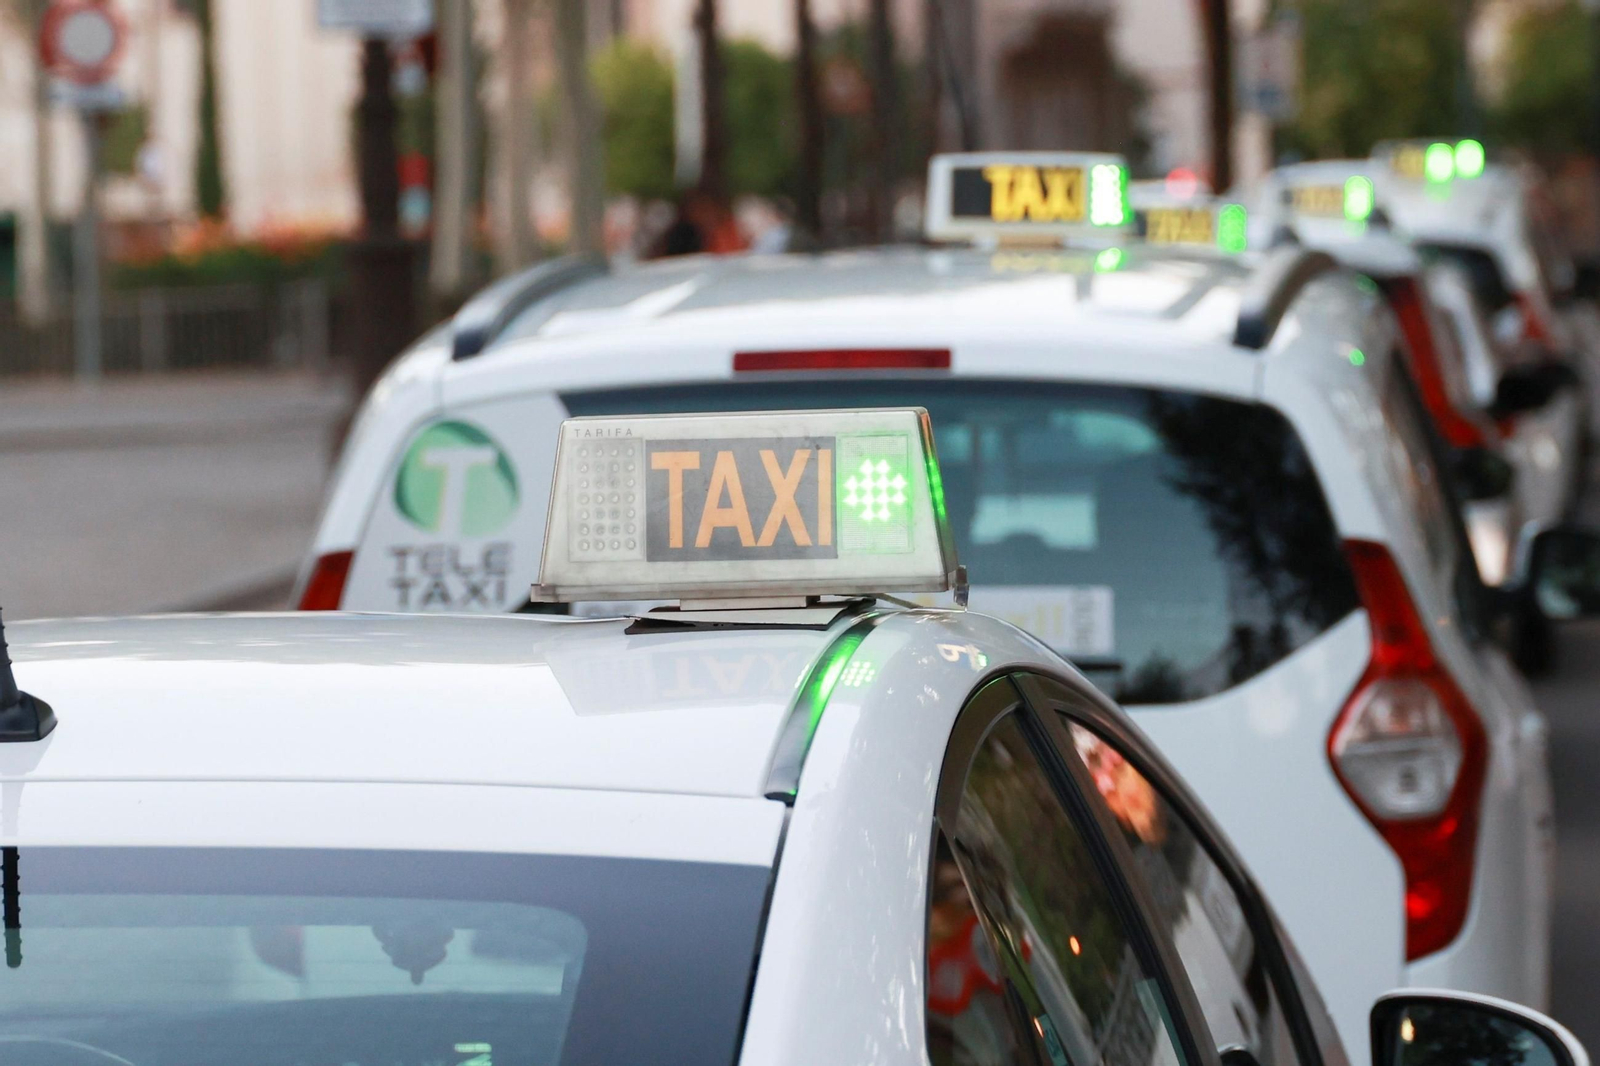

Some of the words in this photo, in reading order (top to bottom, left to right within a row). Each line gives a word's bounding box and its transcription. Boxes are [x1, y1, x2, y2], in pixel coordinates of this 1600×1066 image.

[982, 164, 1085, 223] TAXI
[574, 427, 634, 437] TARIFA
[650, 449, 832, 549] TAXI
[388, 543, 512, 575] TELE
[390, 577, 507, 607] TAXI
